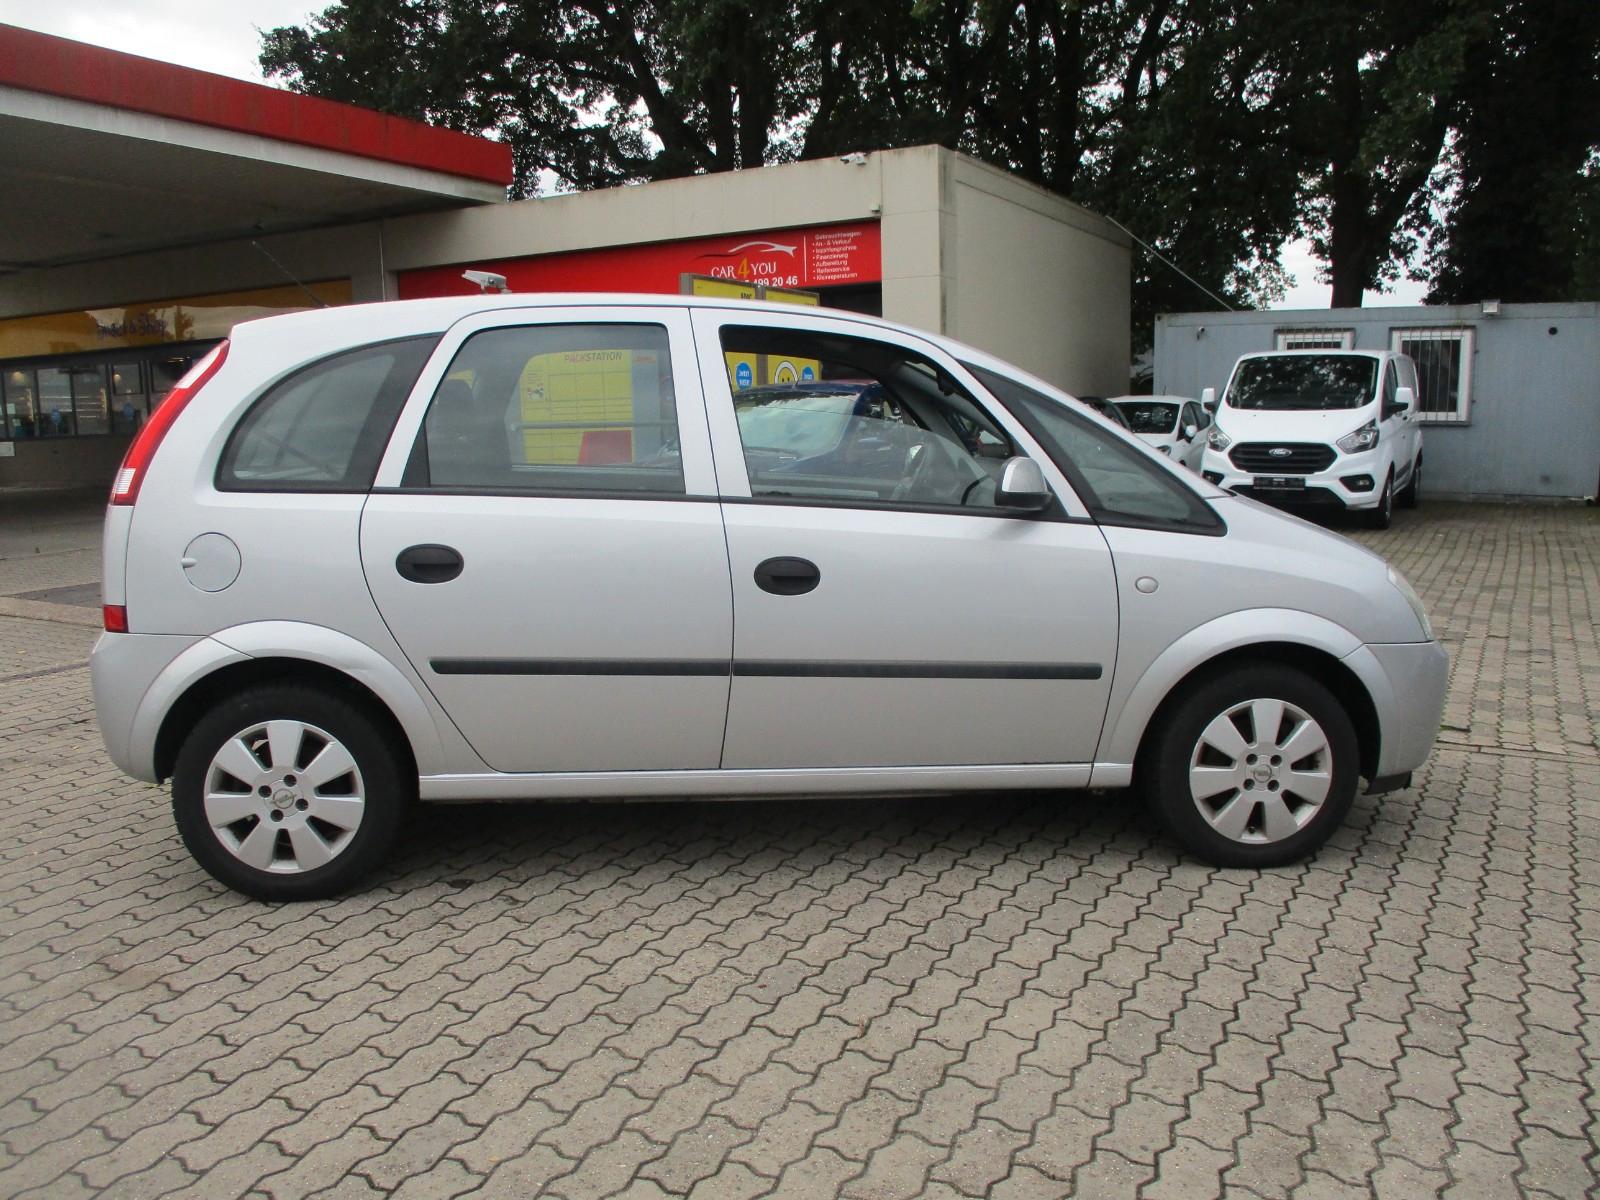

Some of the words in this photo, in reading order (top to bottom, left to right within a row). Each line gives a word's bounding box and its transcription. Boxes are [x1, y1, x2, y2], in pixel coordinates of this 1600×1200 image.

[711, 265, 737, 279] CAR
[738, 257, 750, 278] 4
[751, 262, 776, 276] YOU
[772, 276, 784, 287] 20
[785, 275, 798, 286] 46
[564, 351, 623, 363] PACKSTATION
